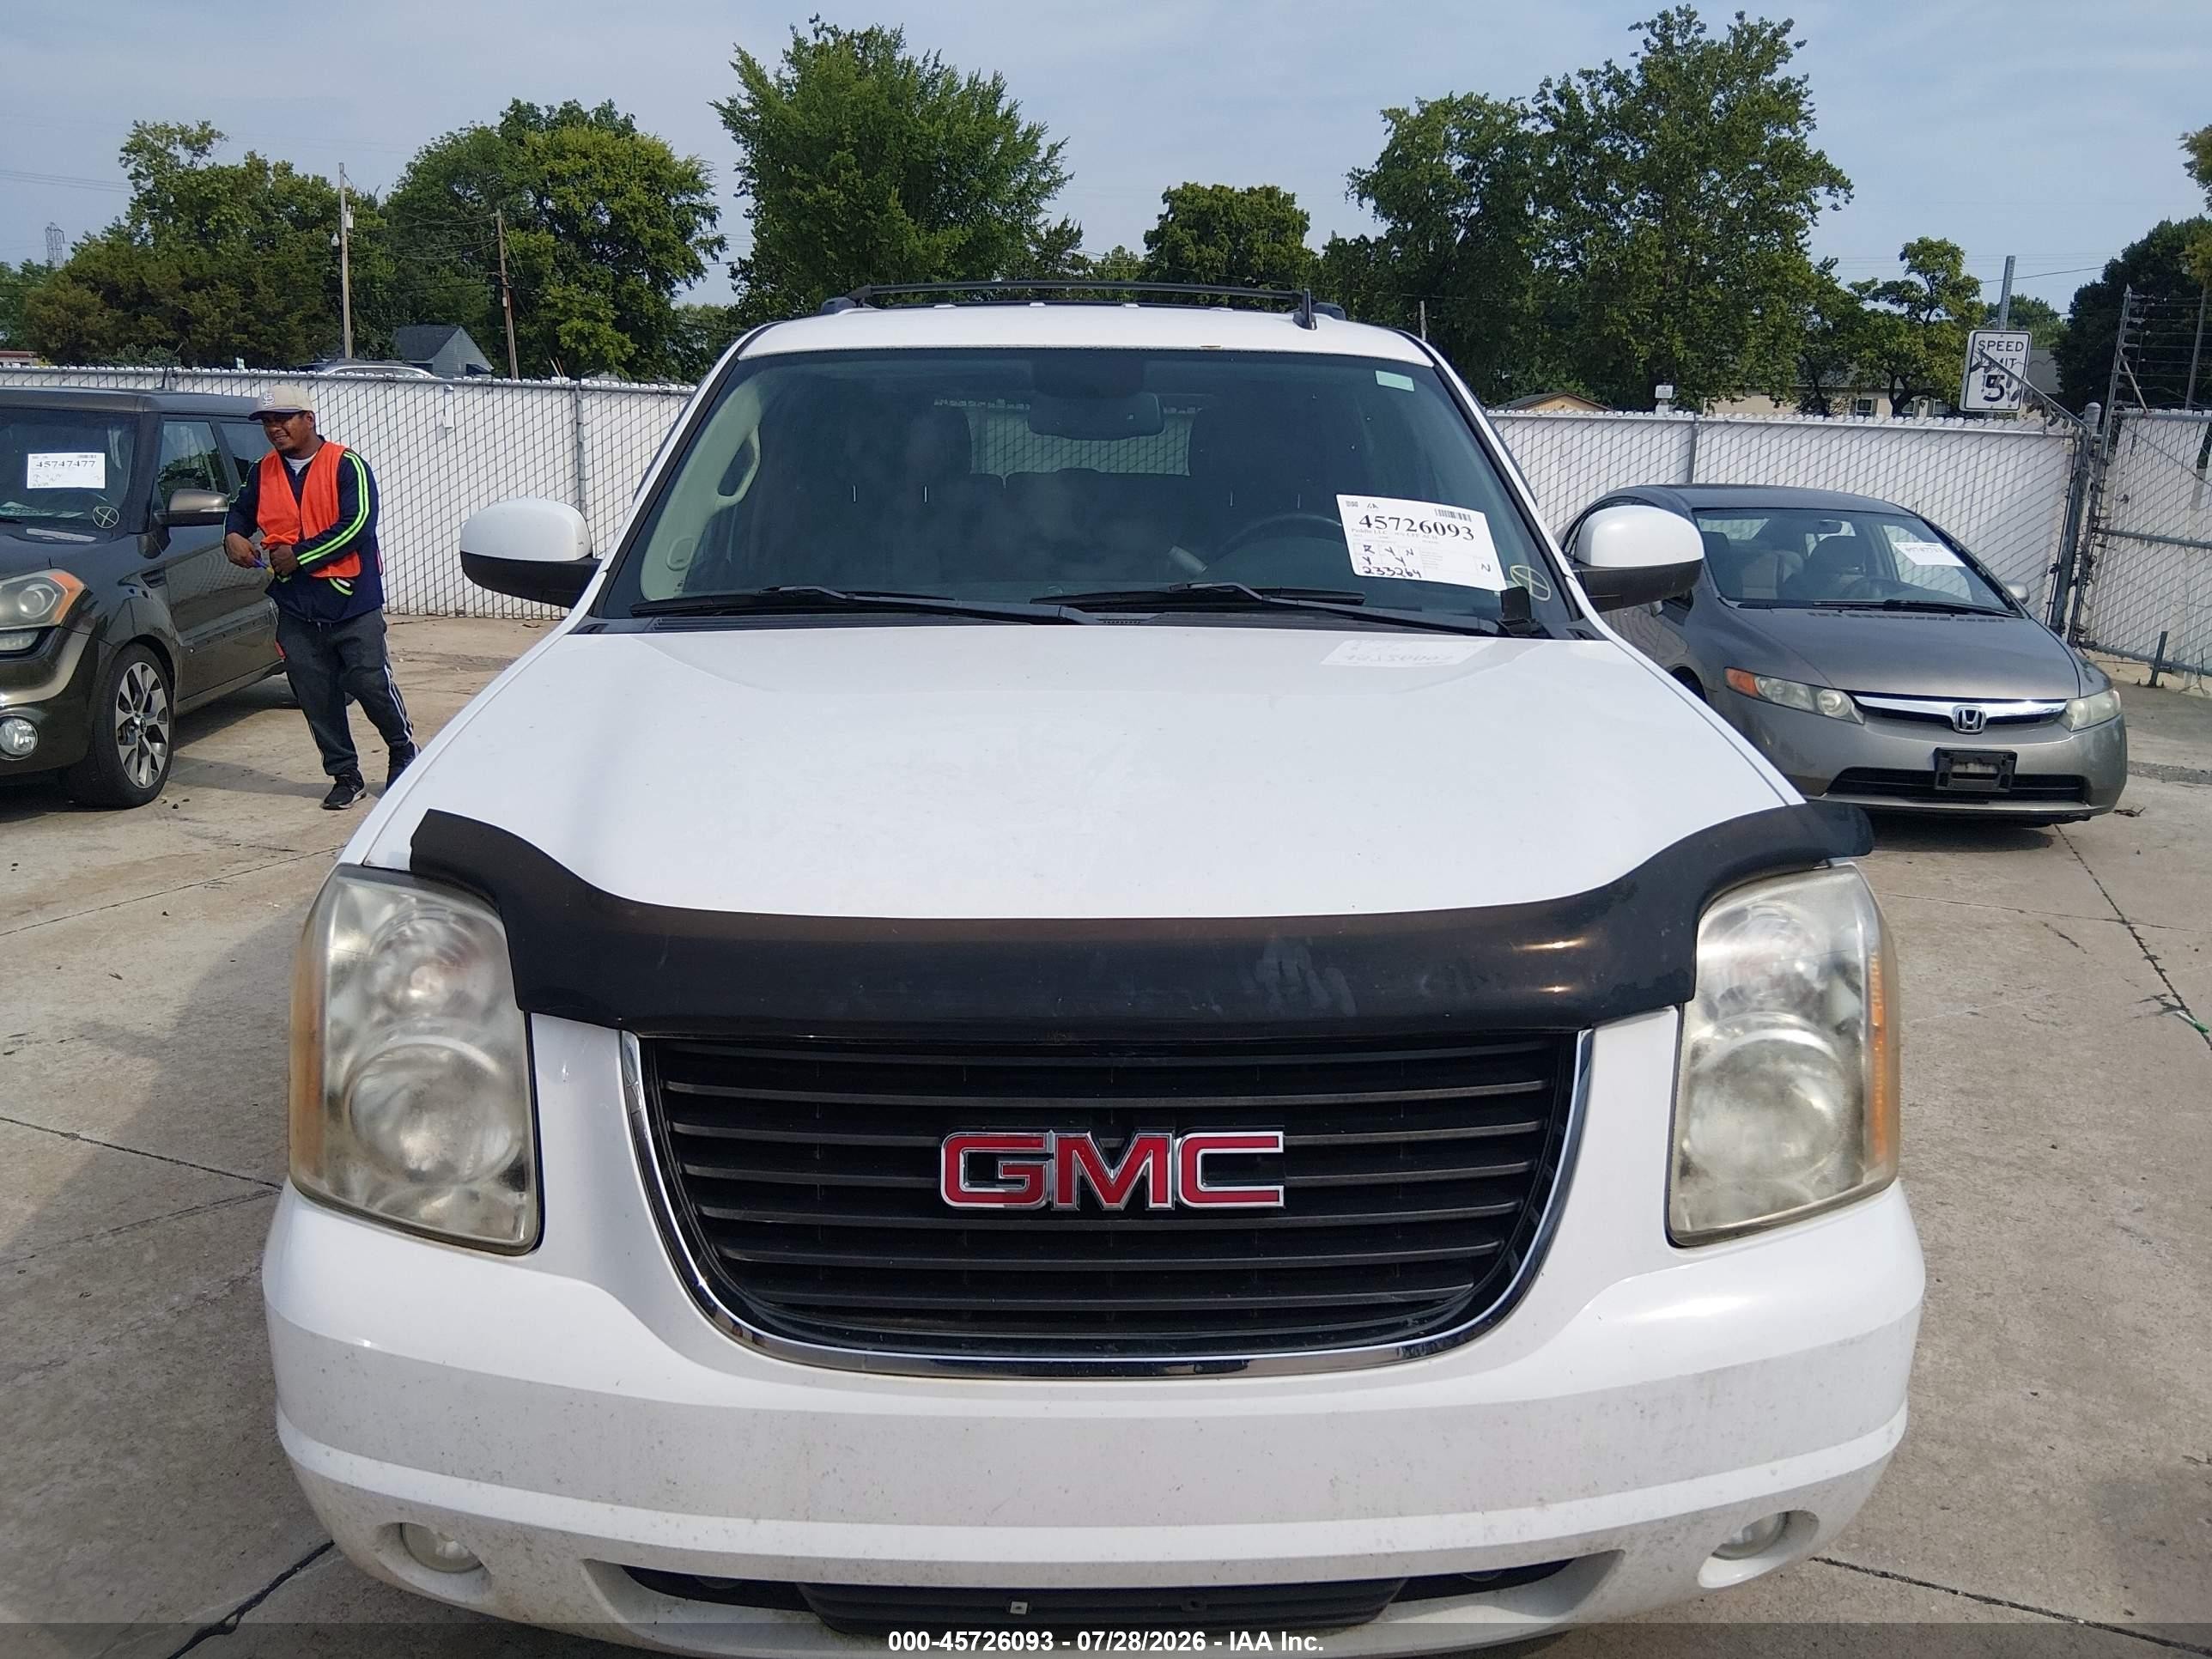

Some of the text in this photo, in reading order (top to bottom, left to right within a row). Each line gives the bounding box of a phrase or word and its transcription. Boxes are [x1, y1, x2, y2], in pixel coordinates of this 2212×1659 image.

[1978, 340, 2024, 352] SPEED
[1984, 374, 2005, 402] 5
[1359, 515, 1474, 541] 45726093
[940, 1129, 1285, 1211] GMC
